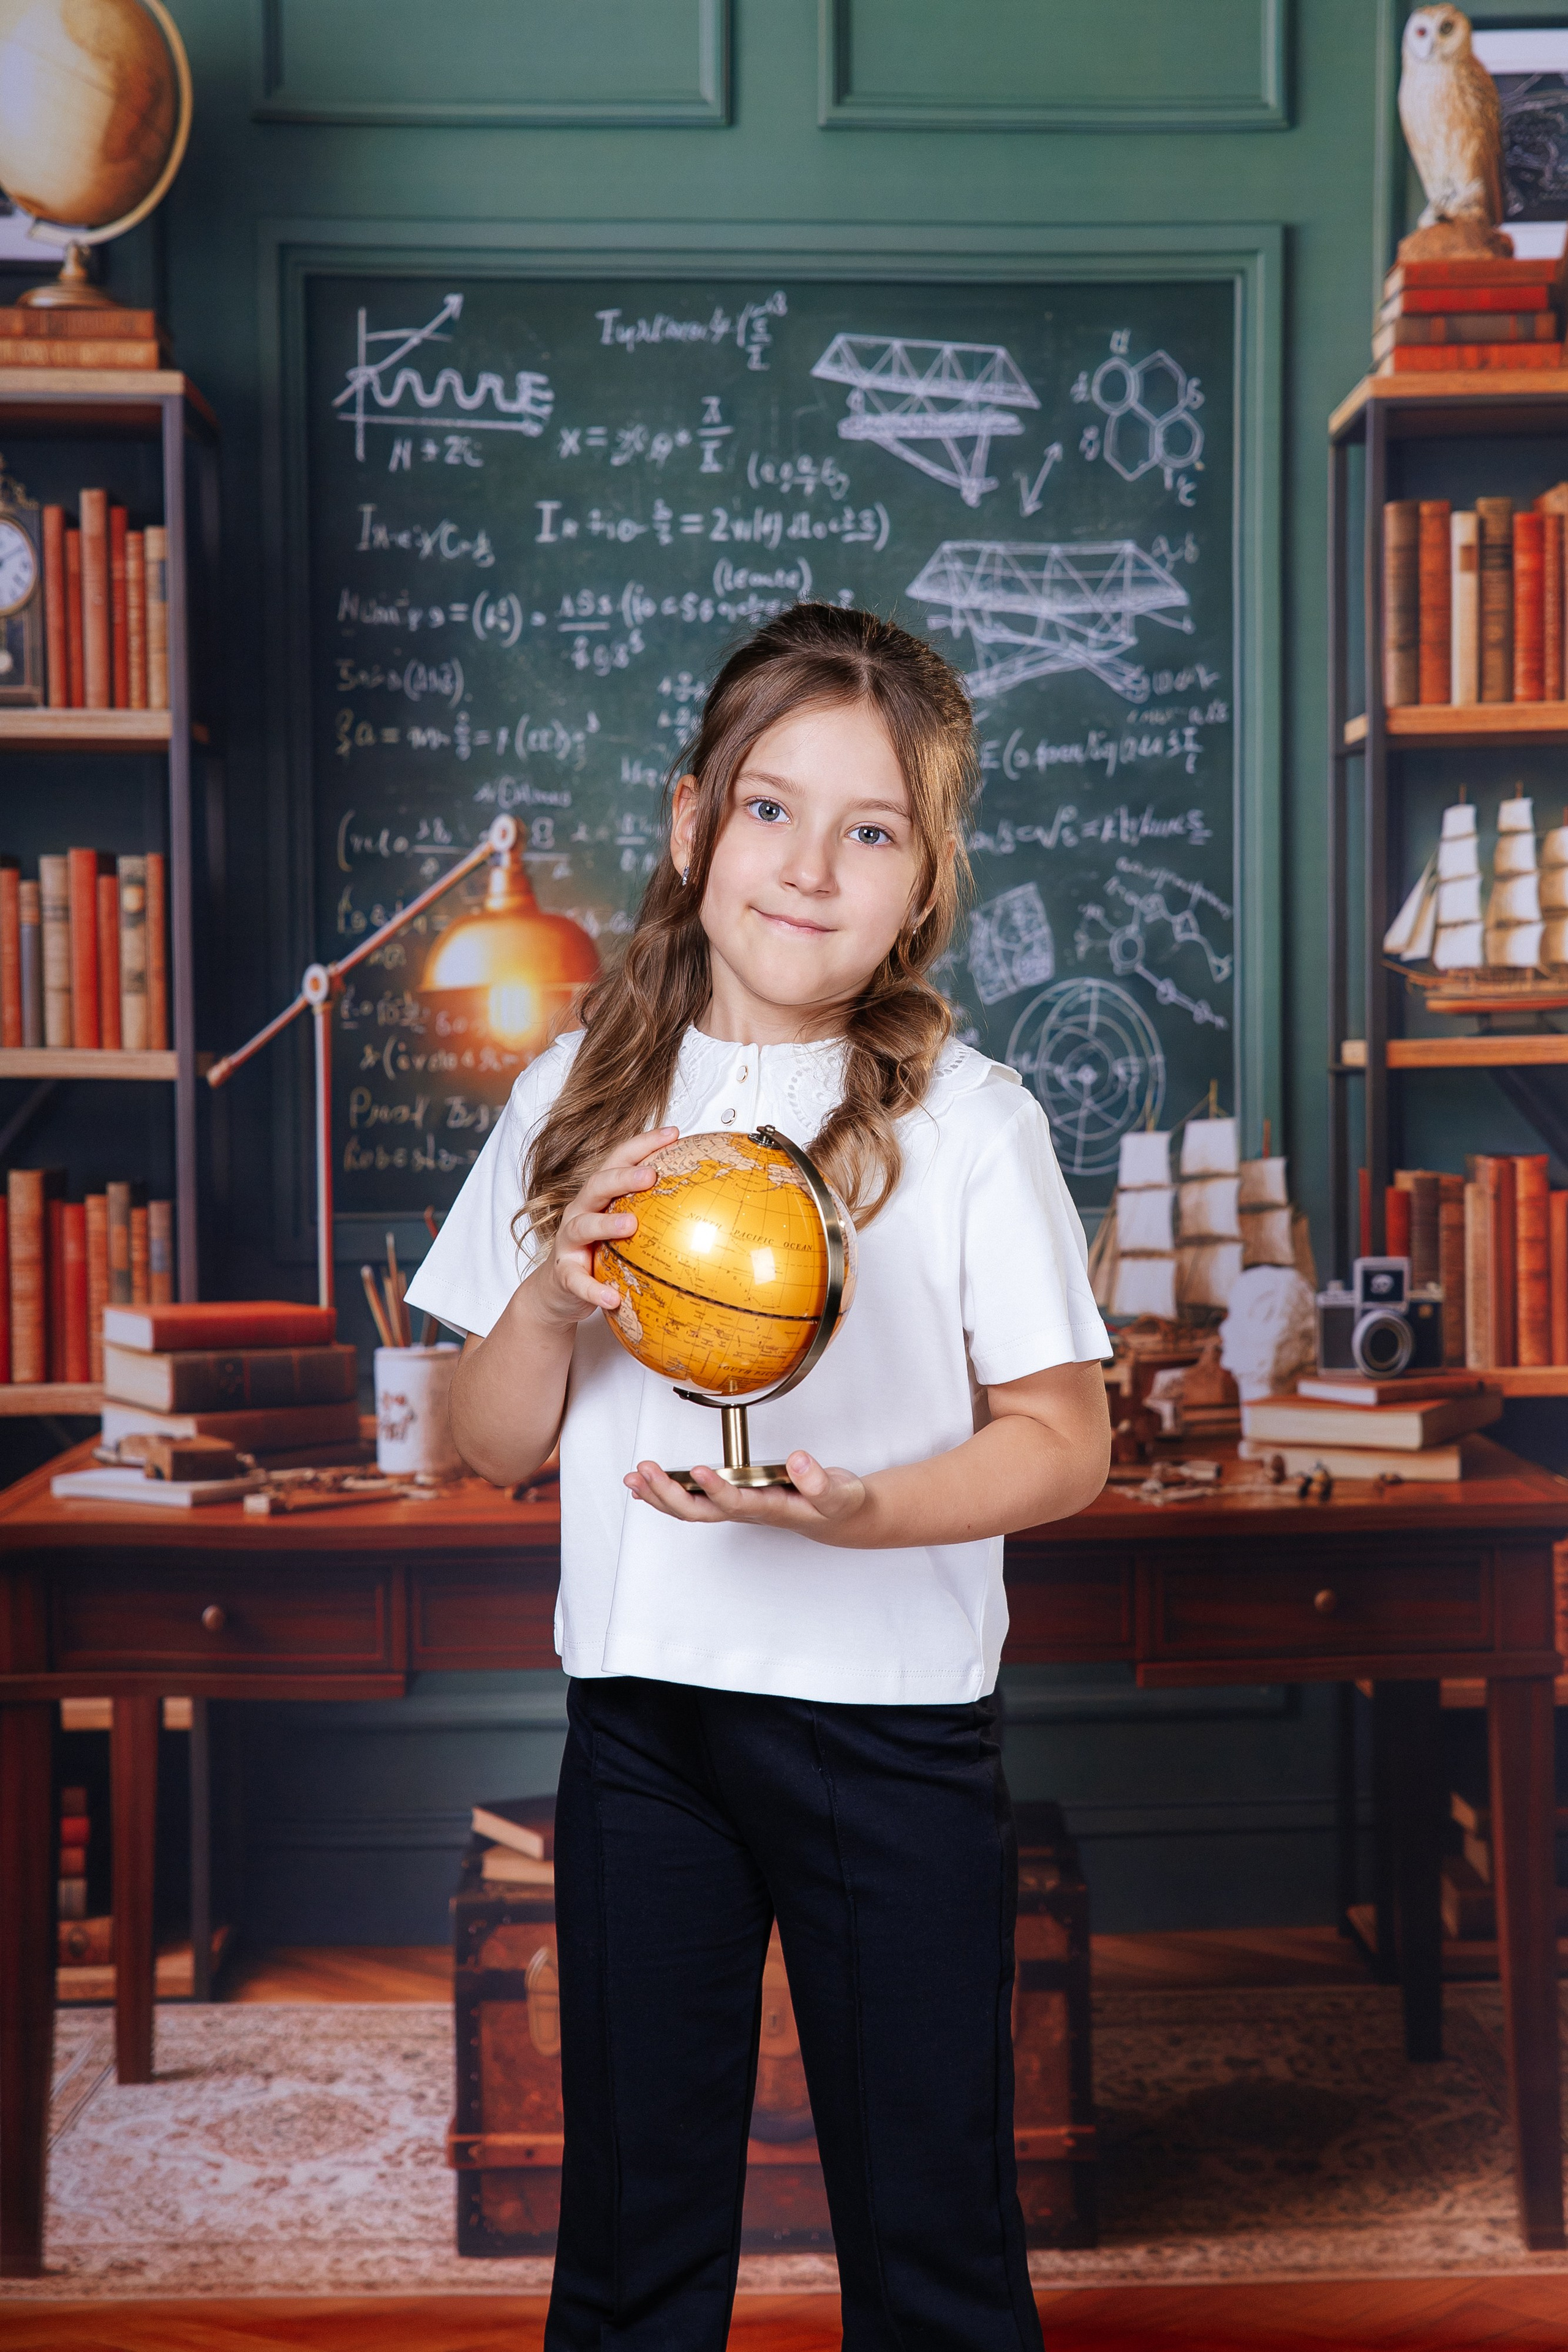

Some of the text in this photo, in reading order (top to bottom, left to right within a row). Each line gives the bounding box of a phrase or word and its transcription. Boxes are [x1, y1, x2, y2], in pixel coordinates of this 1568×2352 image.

[687, 1212, 813, 1251] NORTH PACIFIC OCEAN
